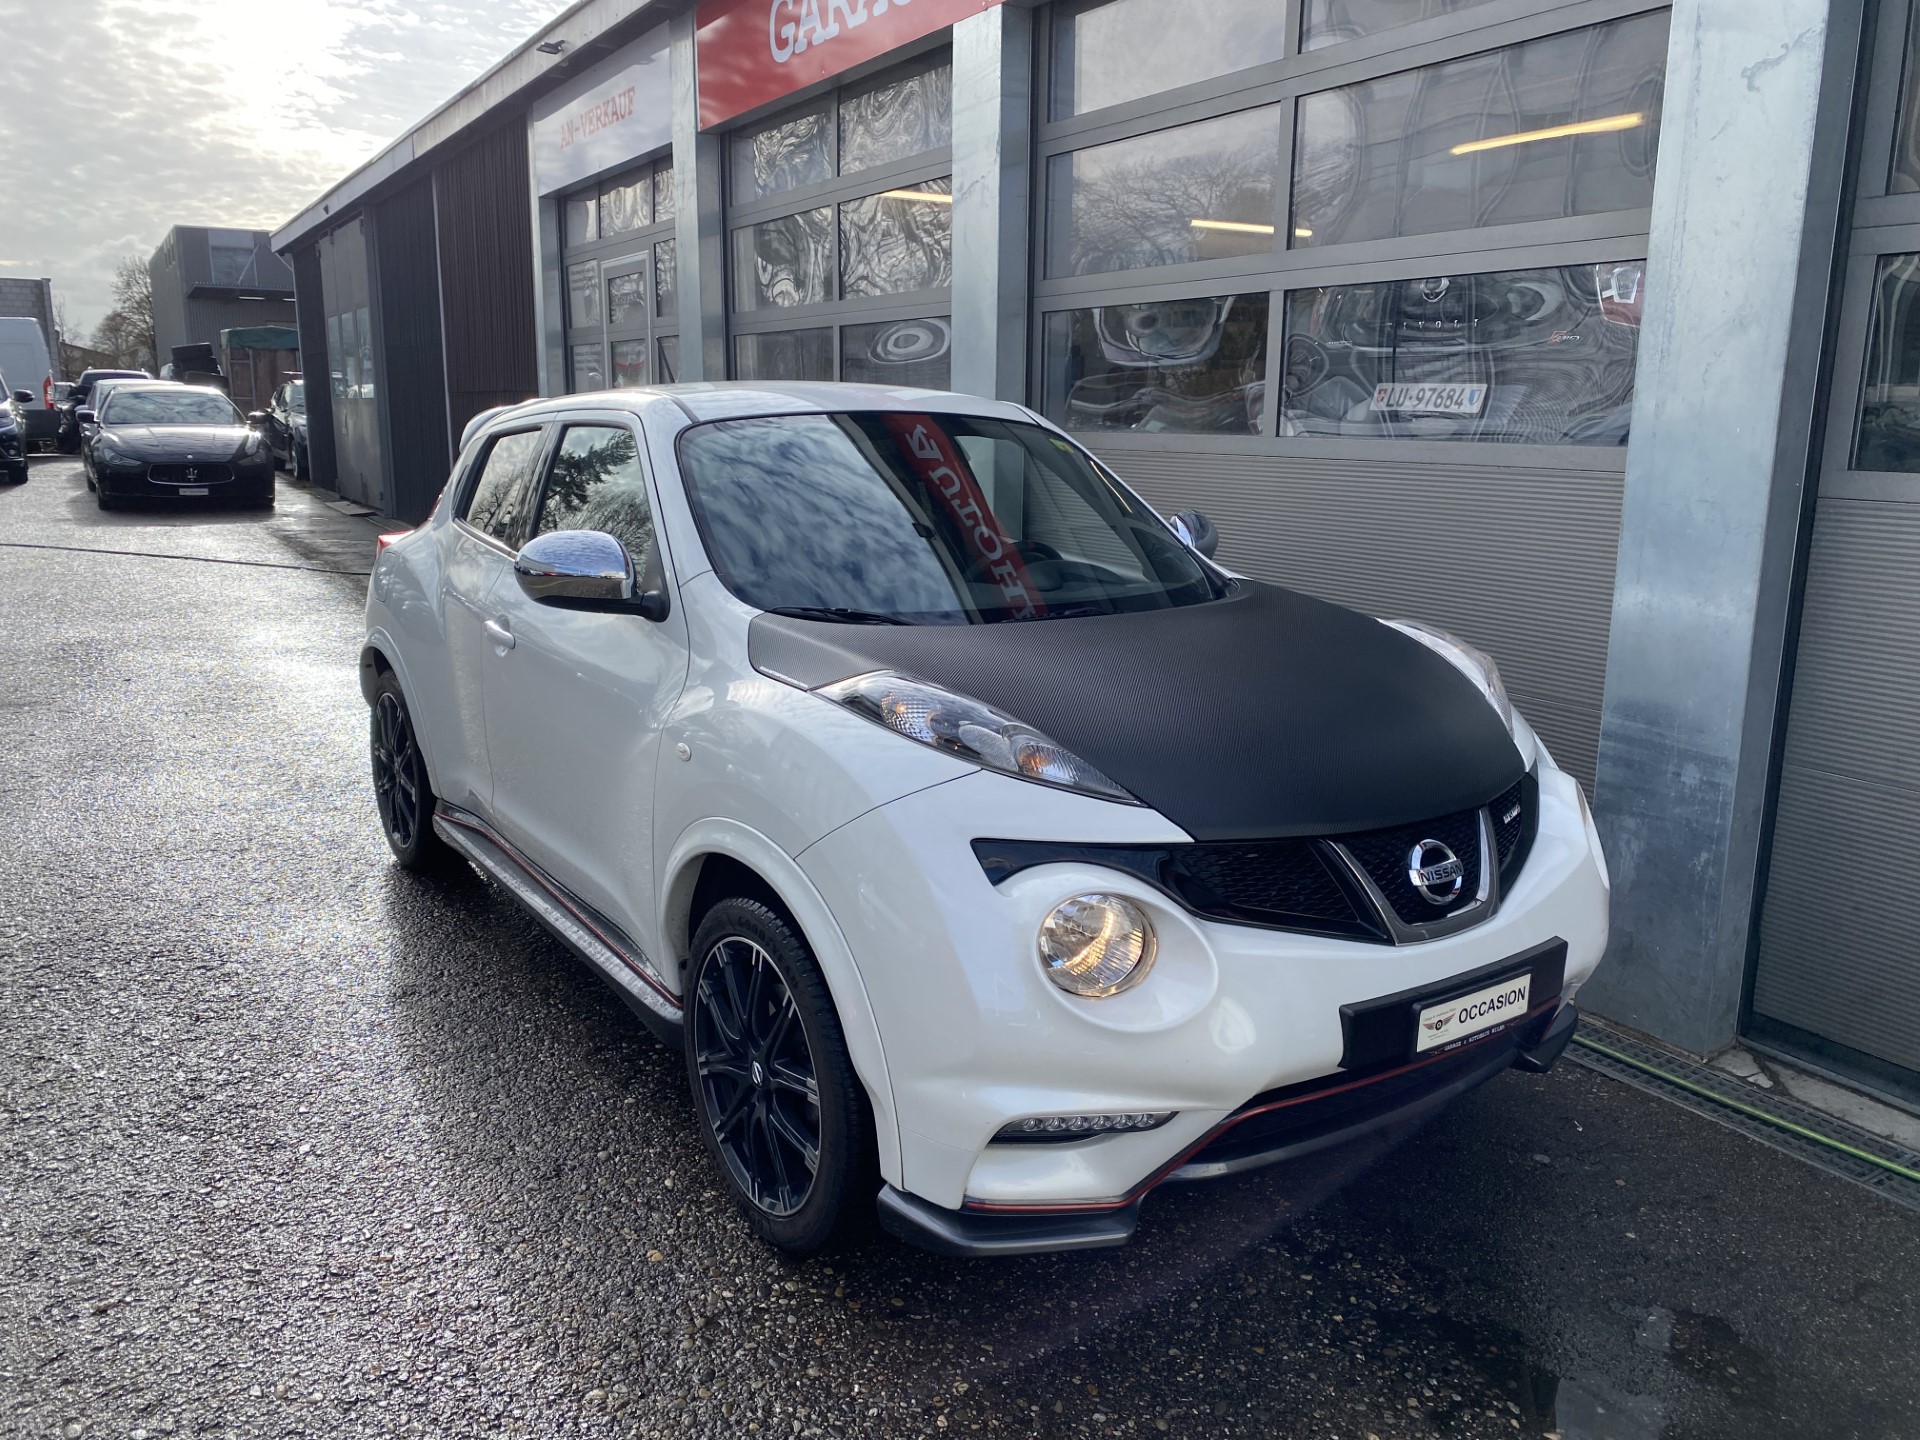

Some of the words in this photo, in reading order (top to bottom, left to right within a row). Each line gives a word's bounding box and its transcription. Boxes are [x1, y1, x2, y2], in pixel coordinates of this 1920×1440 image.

[769, 0, 912, 63] GAR
[560, 85, 636, 149] AN-VERKAUF
[1420, 864, 1463, 883] NISSAN
[1458, 985, 1527, 1024] OCCASION
